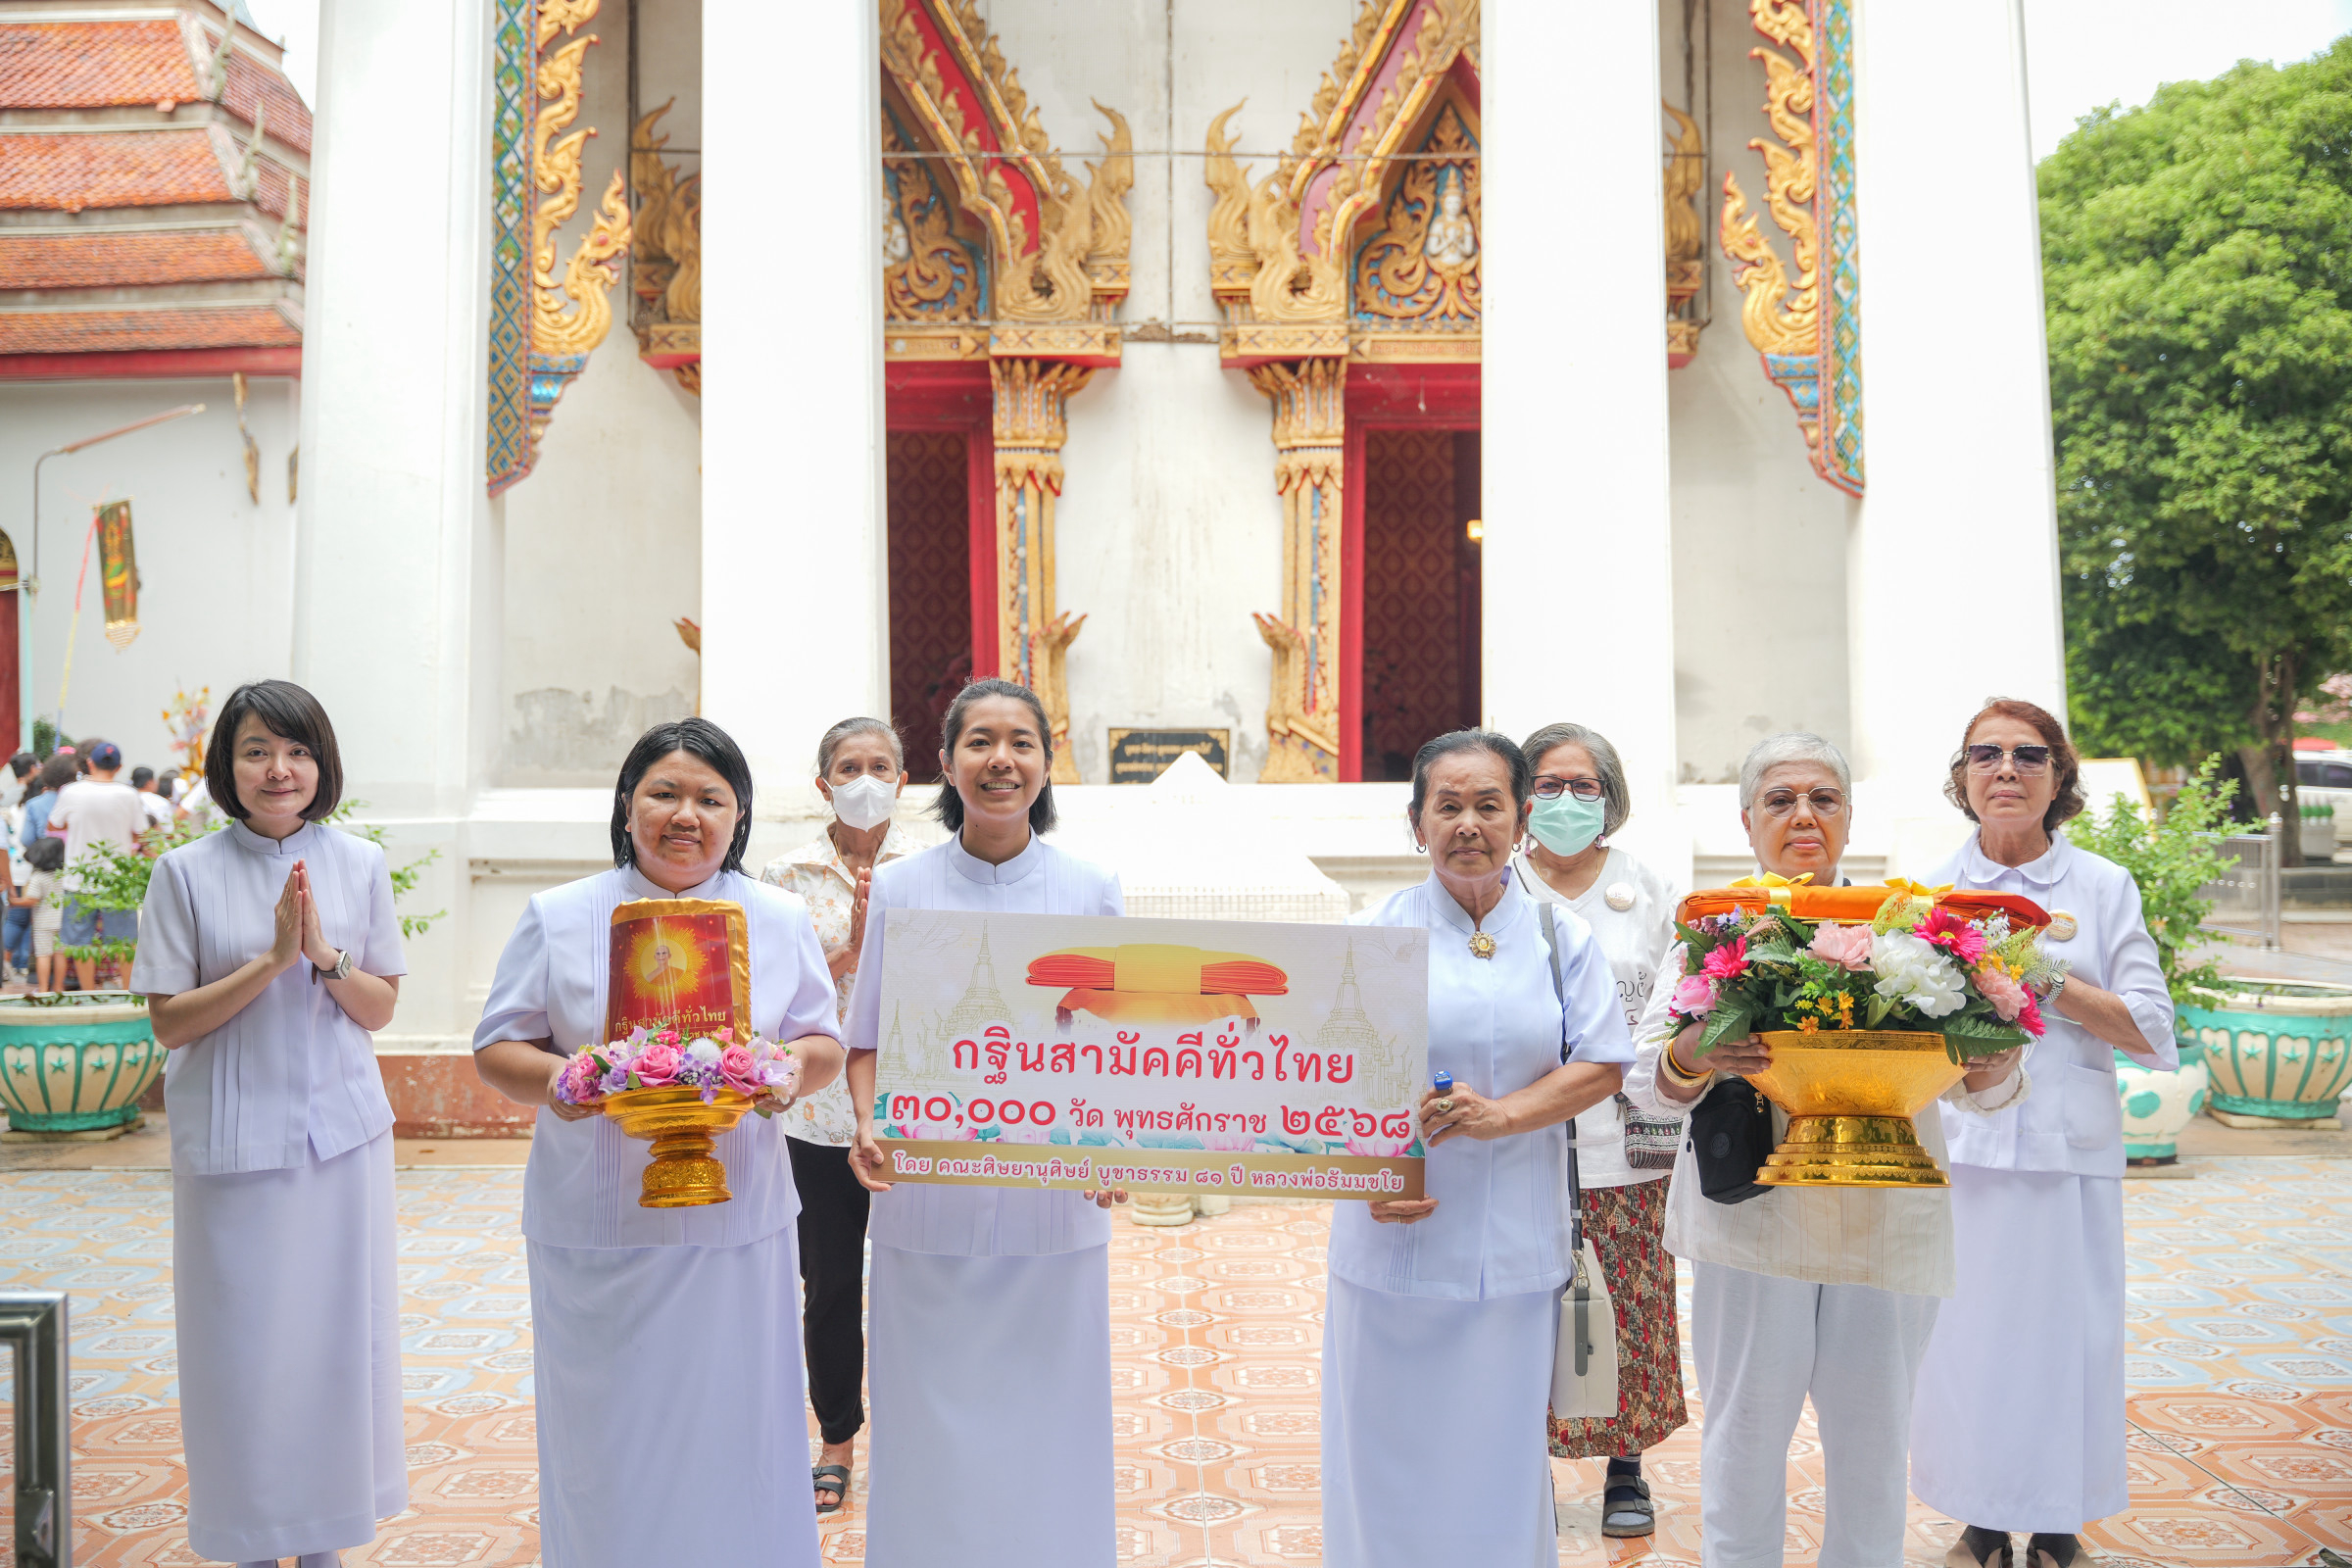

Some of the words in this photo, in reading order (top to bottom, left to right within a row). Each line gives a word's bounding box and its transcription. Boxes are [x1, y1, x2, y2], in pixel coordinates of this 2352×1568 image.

[953, 1021, 1353, 1085] กฐินสามัคคีทั่วไทย
[892, 1095, 1056, 1129] ๓๐,๐๐๐
[1069, 1098, 1103, 1127] วัด
[1113, 1102, 1267, 1140] พุทธศักราช
[1280, 1104, 1410, 1139] ๒๕๖๘
[895, 1152, 930, 1172] โดย
[939, 1157, 1090, 1184] คณะศิษยานุศิษย์
[1098, 1166, 1187, 1187] บูชาธรรม
[1196, 1170, 1222, 1185] ๘๑
[1230, 1166, 1244, 1185] ปี
[1251, 1169, 1403, 1190] หลวงพ่อธัมมชโย
